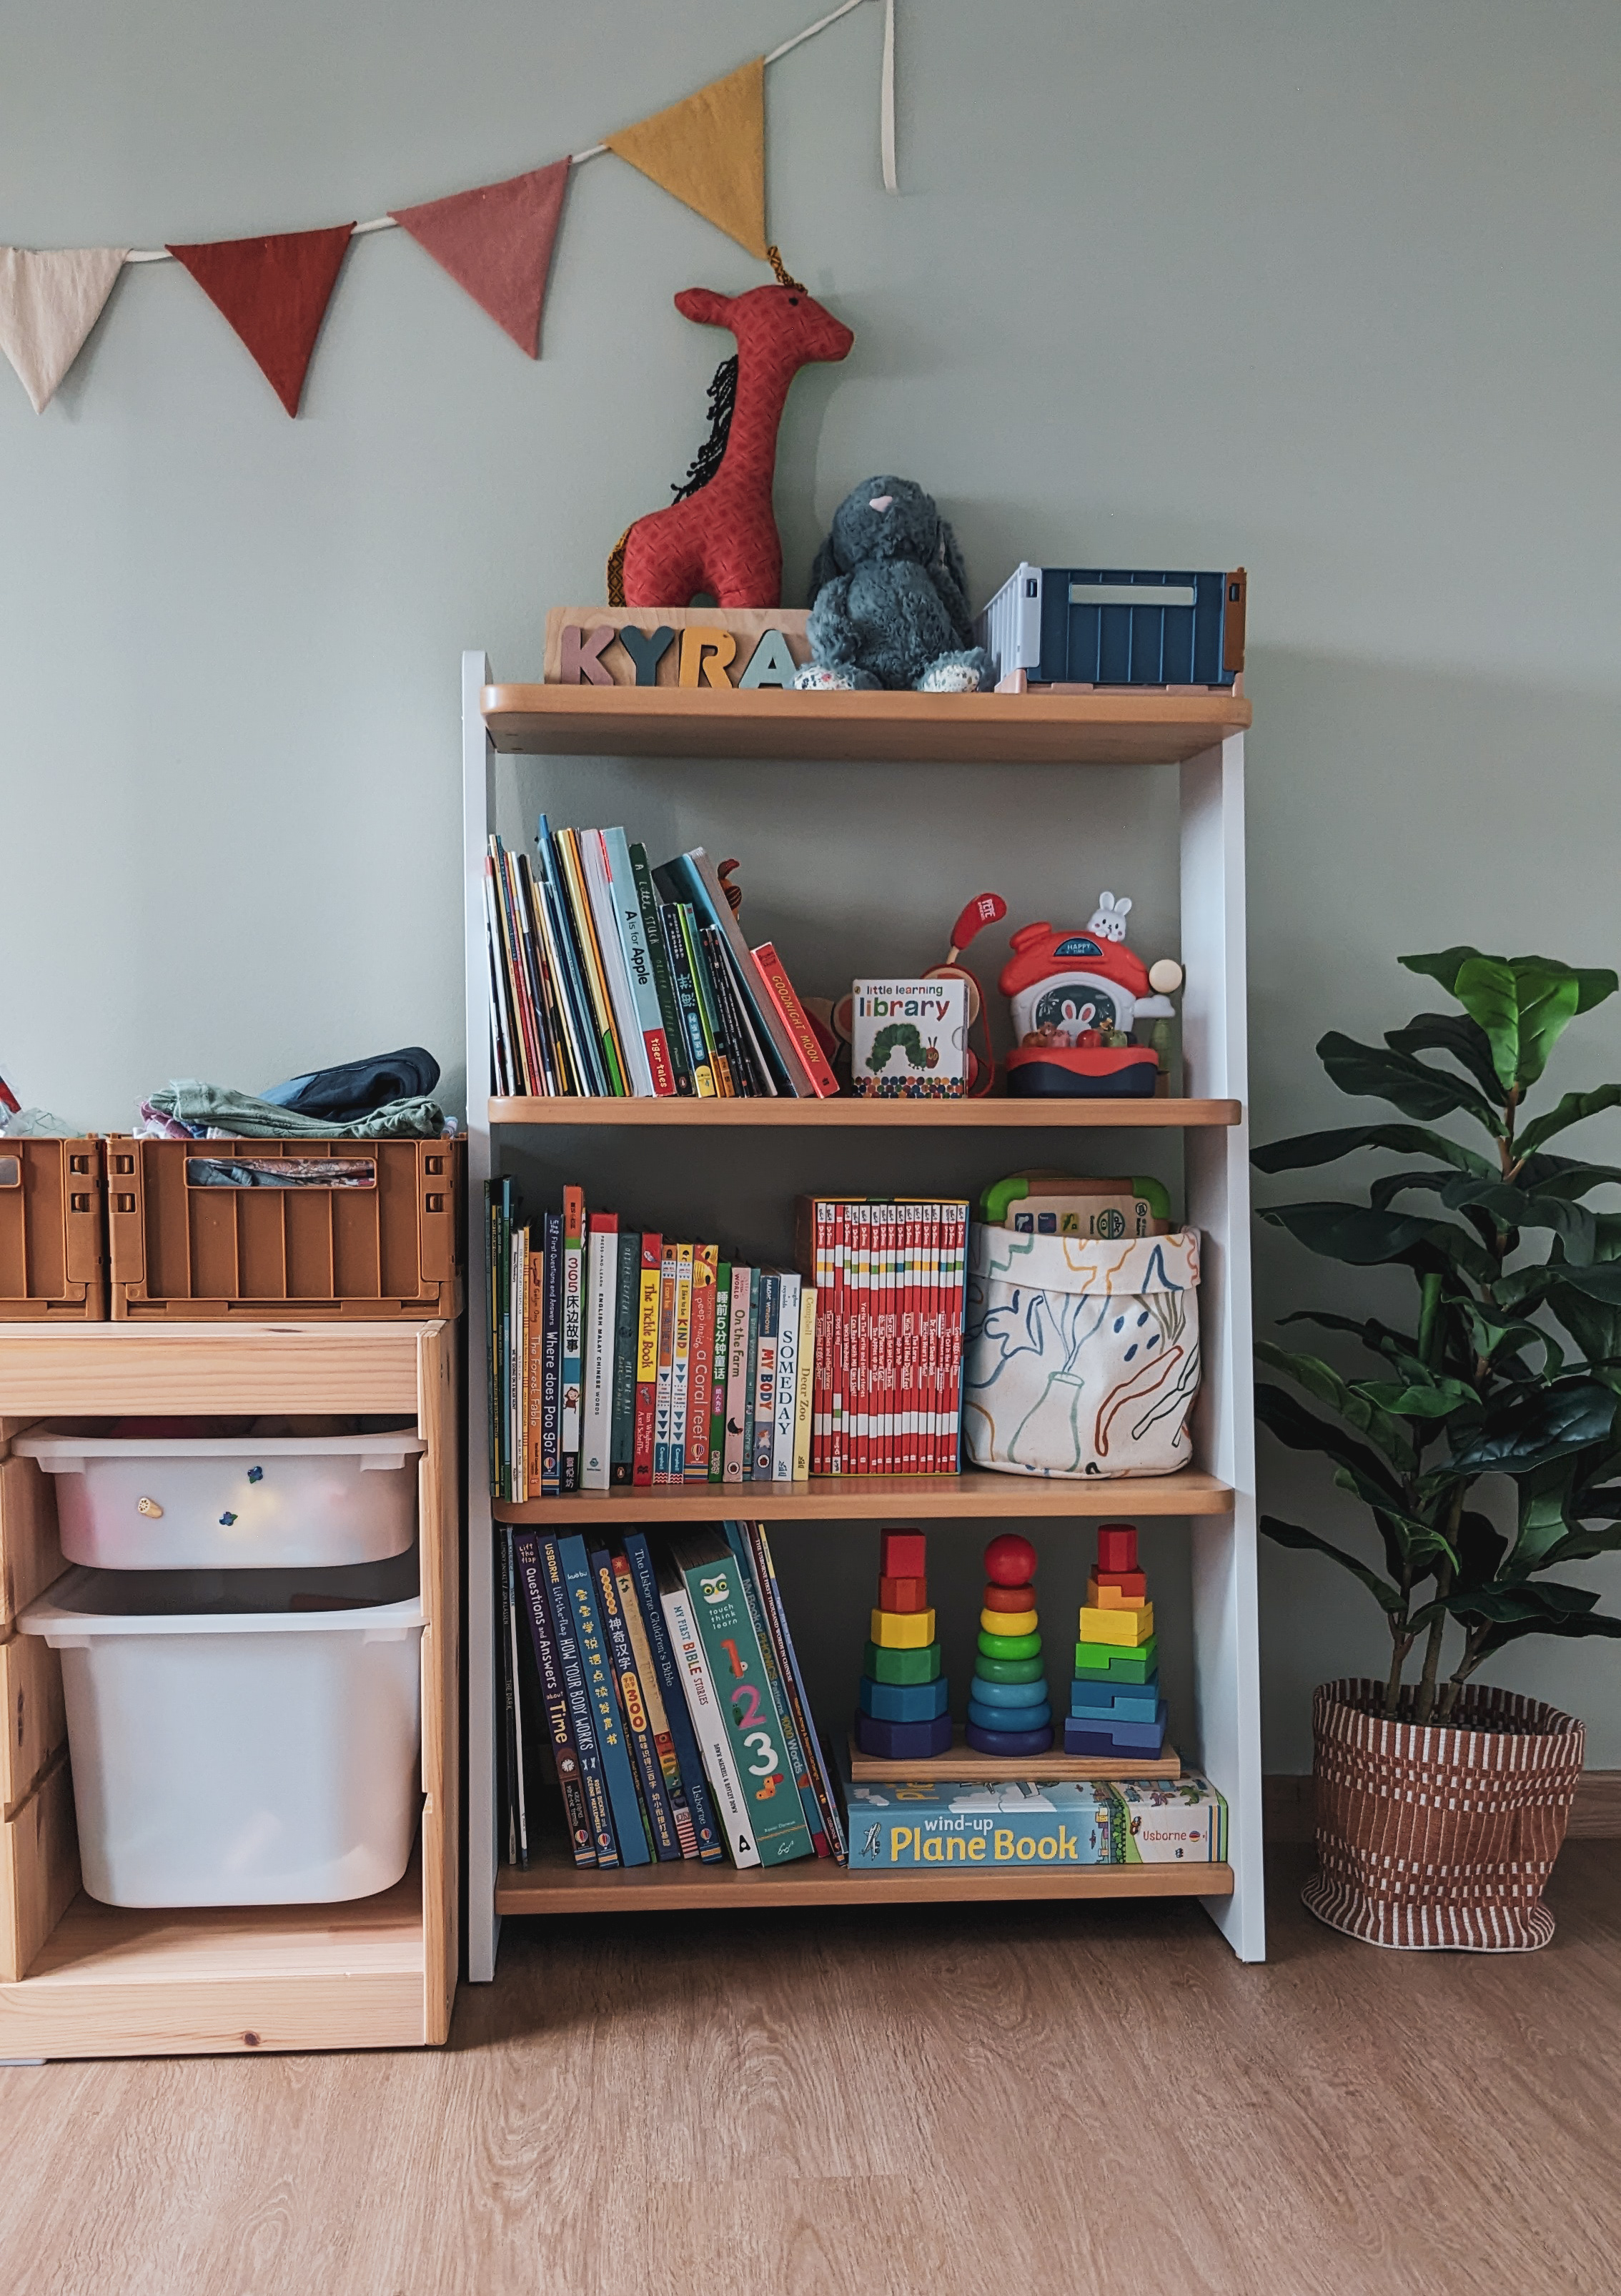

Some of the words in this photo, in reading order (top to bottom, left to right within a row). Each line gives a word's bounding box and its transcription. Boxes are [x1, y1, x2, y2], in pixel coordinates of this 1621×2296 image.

[560, 625, 795, 690] KYRA
[625, 911, 638, 921] A
[631, 948, 648, 985] Apple
[867, 986, 892, 994] little
[896, 986, 943, 996] learning
[773, 976, 805, 1030] GOODNIGHT
[800, 1035, 820, 1062] MOON
[860, 997, 950, 1021] library
[651, 1038, 662, 1062] tiger
[657, 1064, 667, 1087] tales
[644, 1284, 657, 1302] The
[643, 1306, 655, 1336] Tickle
[695, 1297, 705, 1320] peep
[735, 1310, 745, 1325] On
[804, 1297, 814, 1335] Campbell
[530, 1335, 540, 1354] The
[678, 1319, 688, 1349] KIND
[693, 1324, 706, 1348] inside
[713, 1291, 729, 1380] 睡前5分钟童话
[734, 1327, 744, 1347] the
[545, 1332, 557, 1368] Where
[642, 1340, 653, 1368] Book
[697, 1350, 706, 1360] a
[733, 1350, 744, 1377] Farm
[761, 1349, 774, 1370] MY
[530, 1359, 540, 1395] Forest
[545, 1373, 557, 1400] does
[778, 1330, 795, 1435] SOMEDAY
[801, 1368, 810, 1397] Dear
[759, 1374, 773, 1410] BODY
[530, 1399, 540, 1427] Fable
[799, 1400, 809, 1420] Zoo
[693, 1410, 708, 1441] reef
[543, 1432, 555, 1453] go?
[545, 1543, 560, 1583] USBORNE
[525, 1568, 545, 1625] Questions
[743, 1578, 753, 1594] My
[552, 1586, 568, 1636] Lift-the-flap
[634, 1549, 645, 1569] The
[640, 1570, 655, 1611] Usborne
[649, 1611, 667, 1661] Children's
[661, 1661, 674, 1687] Bible
[673, 1605, 683, 1617] MY
[709, 1604, 734, 1615] touch
[711, 1610, 736, 1623] think
[747, 1594, 760, 1623] Book
[758, 1552, 766, 1578] USBORNE
[768, 1595, 779, 1628] THOUSAND
[775, 1628, 785, 1650] WORDS
[782, 1657, 793, 1683] CHINESE
[677, 1620, 690, 1641] FIRST
[713, 1619, 738, 1630] learn
[754, 1623, 763, 1633] of
[560, 1638, 577, 1659] HOW
[608, 1617, 631, 1670] 神奇汉字
[539, 1641, 556, 1689] Answers
[683, 1641, 703, 1676] BIBLE
[720, 1638, 744, 1679] 1
[565, 1662, 582, 1689] YOUR
[545, 1691, 564, 1700] about
[571, 1691, 588, 1714] BODY
[693, 1678, 708, 1706] STORIES
[770, 1681, 785, 1715] Patterns
[549, 1700, 567, 1743] Time
[627, 1690, 645, 1728] 300
[730, 1684, 767, 1730] 2
[575, 1717, 593, 1751] WORKS
[744, 1732, 778, 1776] 3
[788, 1738, 803, 1774] Words
[691, 1785, 706, 1825] Usborne
[827, 1816, 837, 1839] USBORNE
[925, 1816, 993, 1834] wind-up
[1143, 1829, 1187, 1842] Usborne
[890, 1828, 986, 1861] Plane
[995, 1825, 1079, 1860] Book
